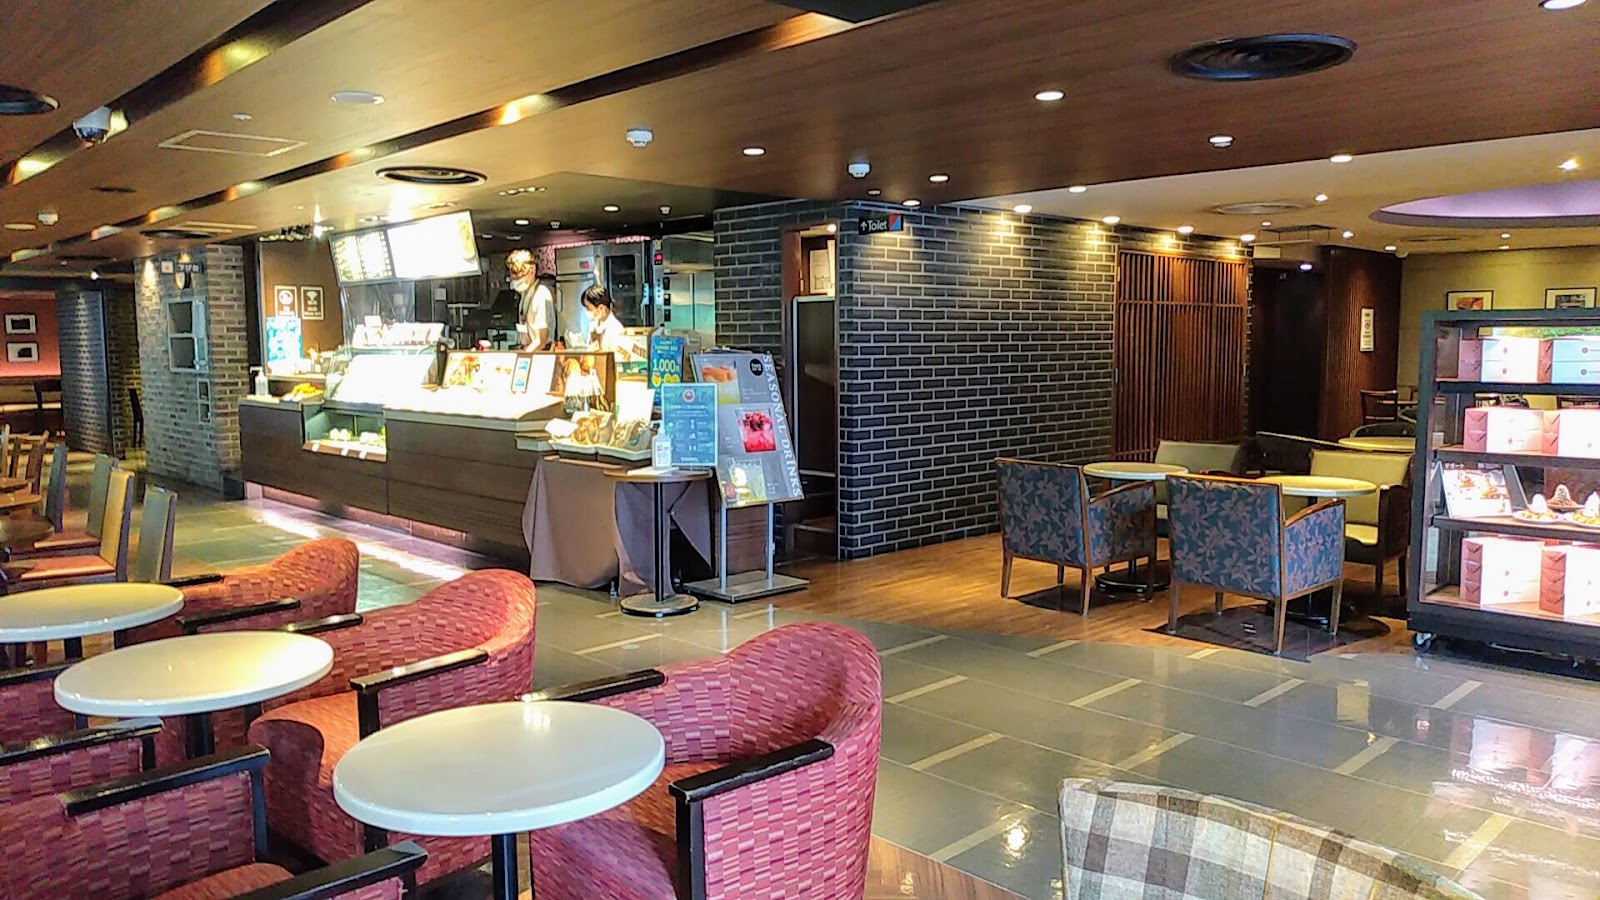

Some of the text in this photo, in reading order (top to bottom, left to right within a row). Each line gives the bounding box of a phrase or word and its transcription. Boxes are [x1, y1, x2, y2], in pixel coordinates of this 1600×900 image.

[867, 219, 888, 232] Toilet
[762, 354, 803, 497] SEASONAL DRINKS
